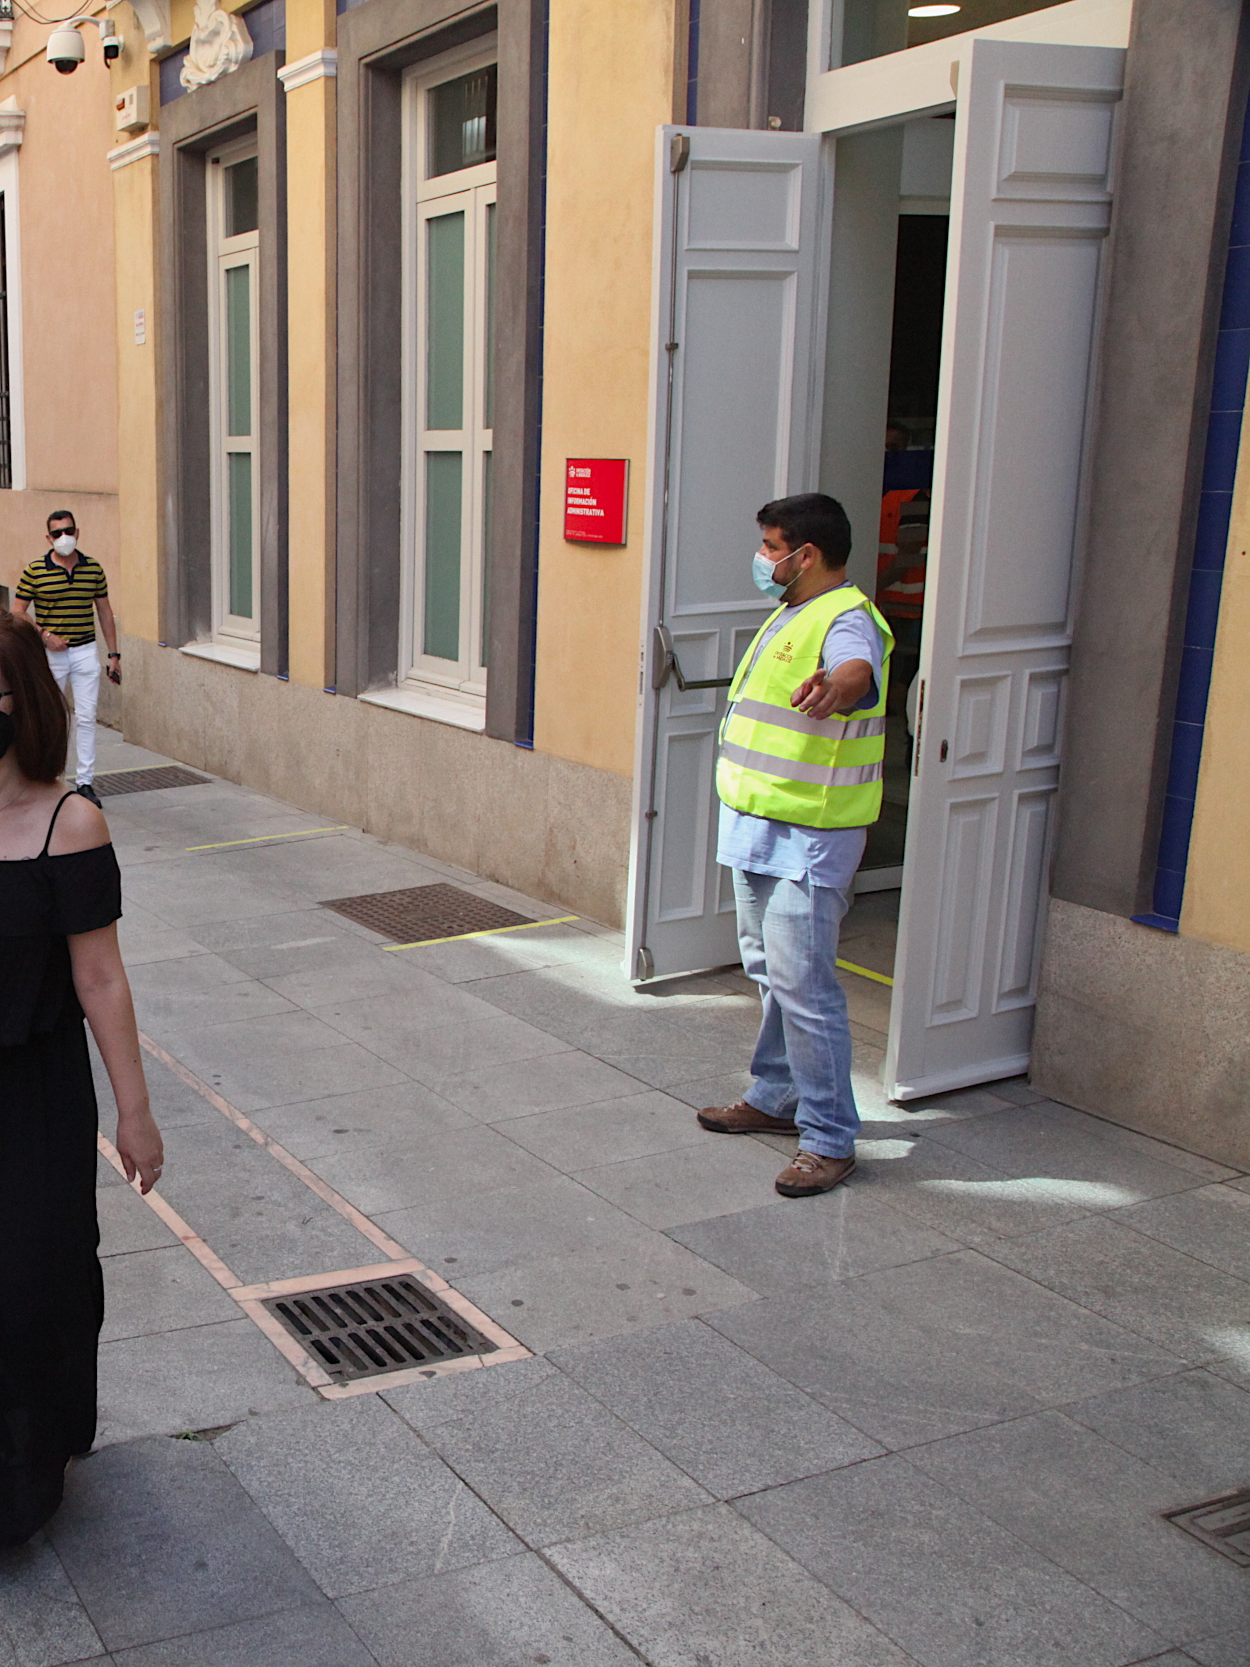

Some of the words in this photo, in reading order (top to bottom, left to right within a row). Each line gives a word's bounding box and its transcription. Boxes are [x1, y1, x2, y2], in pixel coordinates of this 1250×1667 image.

[568, 487, 583, 495] OFICINA
[568, 497, 596, 506] INFORMACIÓN
[567, 507, 604, 516] ADMINISTRATIVA
